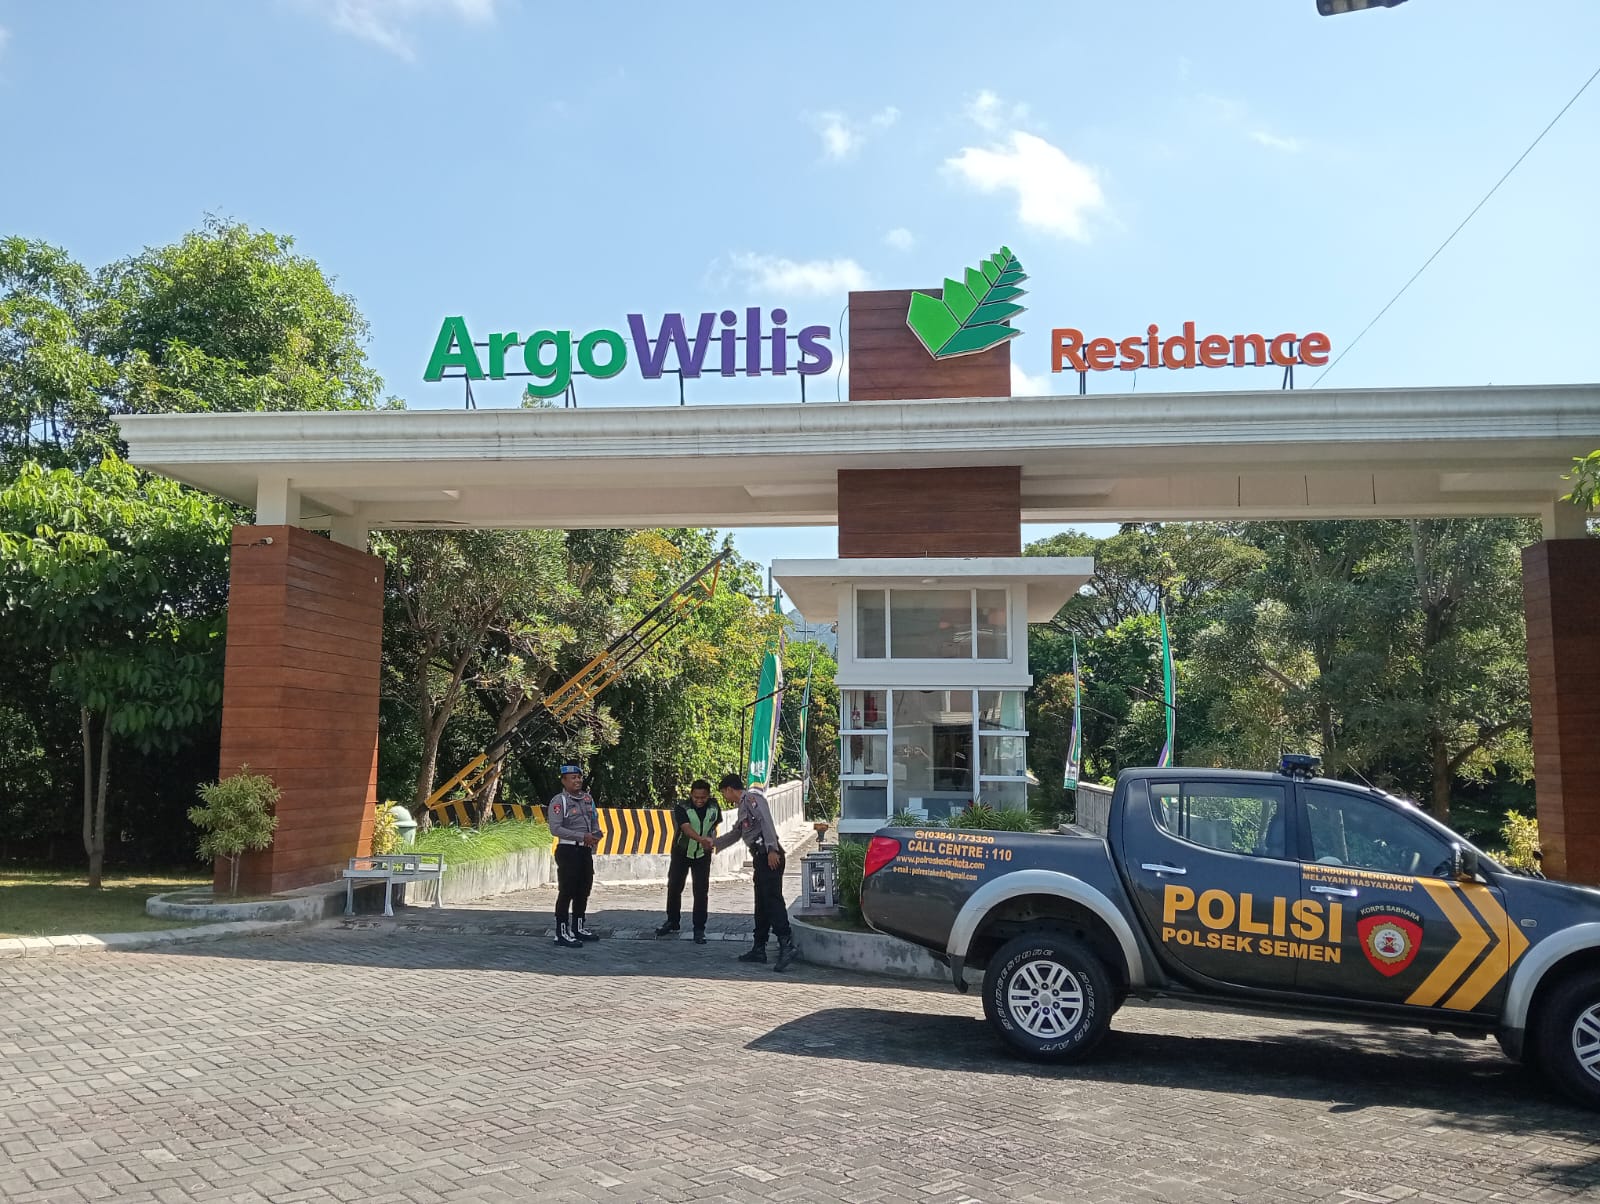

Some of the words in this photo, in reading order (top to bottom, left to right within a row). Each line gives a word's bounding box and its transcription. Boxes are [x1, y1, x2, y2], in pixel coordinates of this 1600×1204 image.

[1051, 321, 1331, 373] Residence
[925, 831, 955, 841] (0354)
[958, 833, 994, 844] 773320
[908, 840, 935, 853] CALL
[938, 843, 983, 858] CENTRE
[992, 848, 1012, 861] 110
[1302, 865, 1358, 877] MELINDUNGI
[1359, 871, 1414, 884] MENGAYOMI
[1302, 873, 1348, 884] MELAYANI
[1350, 879, 1414, 892] MASYARAKAT
[1163, 884, 1343, 943] POLISI
[1360, 905, 1385, 915] KORPS
[1387, 905, 1420, 921] SABHARA
[1162, 927, 1254, 954] POLSEK
[1258, 939, 1342, 964] SEMEN
